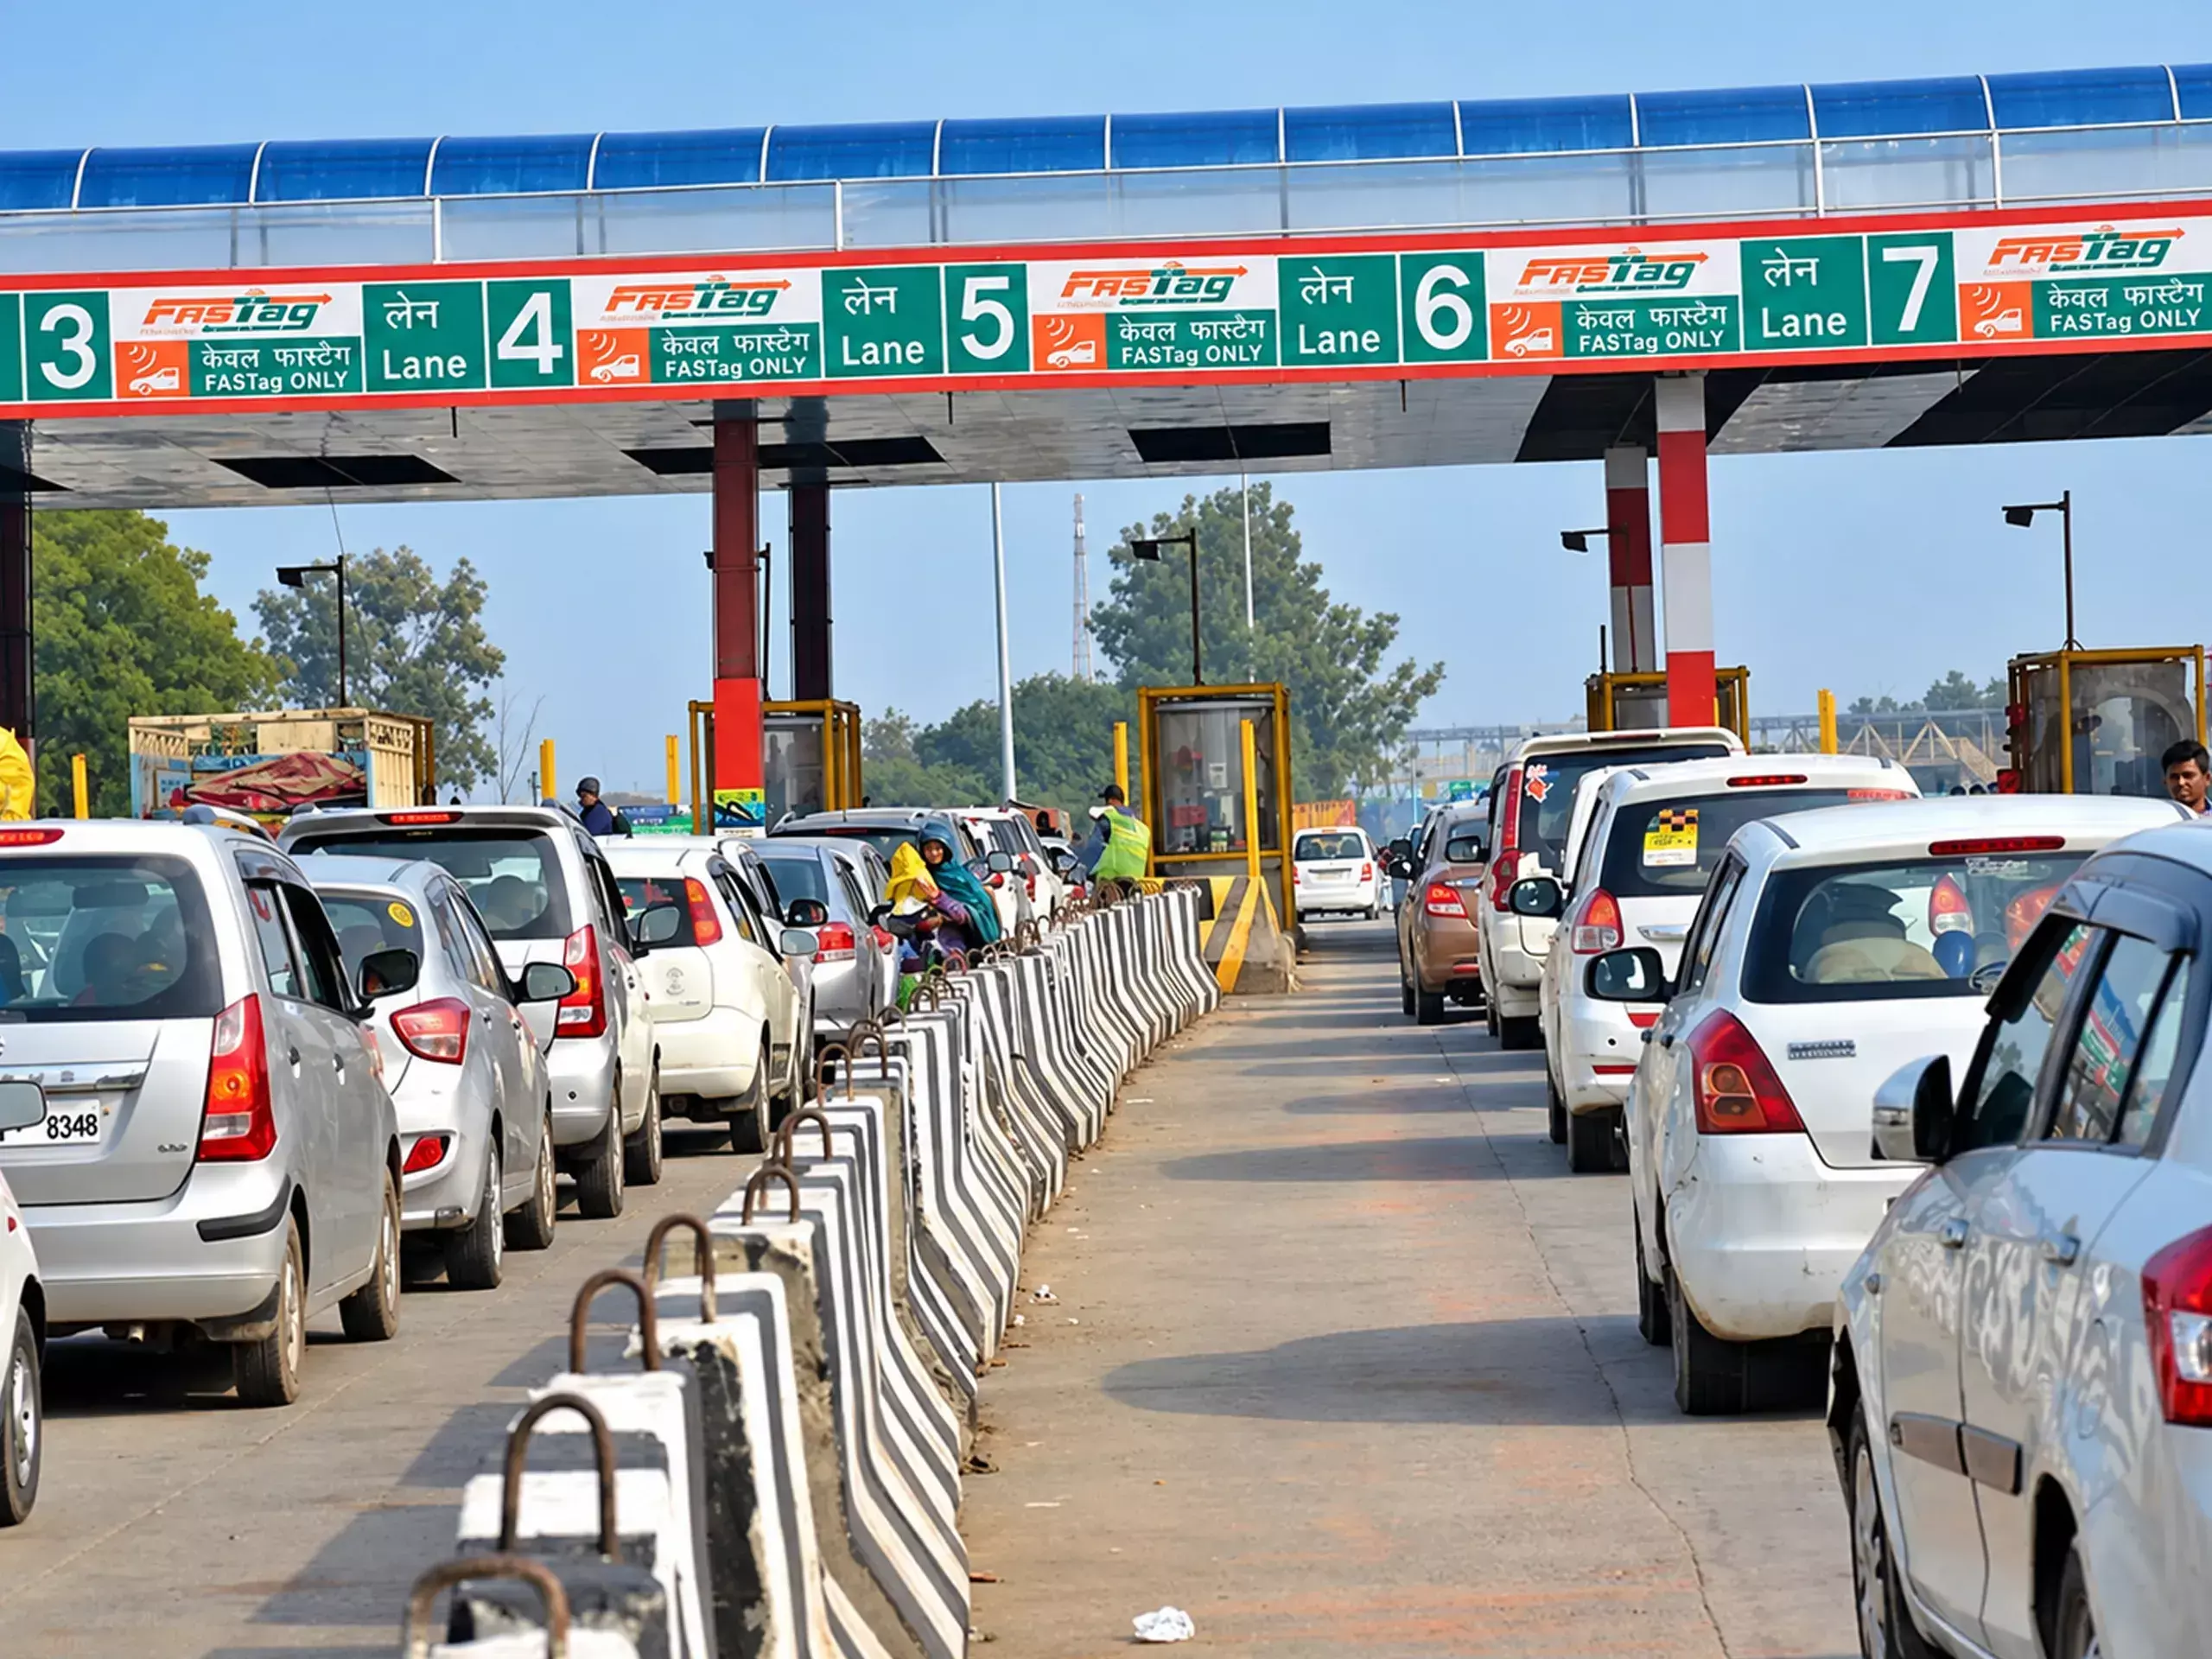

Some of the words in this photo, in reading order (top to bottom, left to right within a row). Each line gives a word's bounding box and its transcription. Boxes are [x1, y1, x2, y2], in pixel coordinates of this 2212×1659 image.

[1762, 248, 1819, 286] लेन
[842, 277, 898, 315] लेन
[1300, 266, 1354, 304] लेन
[1883, 245, 1938, 331] 7
[2047, 283, 2109, 308] केवल
[2123, 277, 2204, 307] फास्टैग
[384, 291, 439, 328] लेन
[962, 276, 1014, 359] 5
[1415, 265, 1472, 349] 6
[1575, 304, 1636, 330] केवल
[1648, 300, 1727, 327] फास्टैग
[2050, 314, 2132, 333] FASTag
[2139, 308, 2202, 328] ONLY
[498, 293, 563, 373] 4
[1118, 315, 1176, 342] केवल
[1189, 313, 1266, 340] फास्टैग
[1763, 308, 1846, 337] Lane
[41, 304, 95, 389] 3
[661, 329, 720, 355] केवल
[734, 326, 810, 354] फास्टैग
[843, 336, 924, 365] Lane
[1300, 325, 1380, 353] Lane
[1580, 334, 1658, 355] FASTag
[1665, 330, 1724, 349] ONLY
[201, 343, 260, 369] केवल
[273, 340, 351, 367] फास्टैग
[384, 350, 466, 378] Lane
[665, 359, 742, 379] FASTag
[749, 357, 806, 375] ONLY
[1122, 346, 1198, 365] FASTag
[1205, 344, 1262, 363] ONLY
[205, 373, 283, 393] FASTag
[290, 371, 348, 389] ONLY
[47, 1114, 98, 1139] 8348
